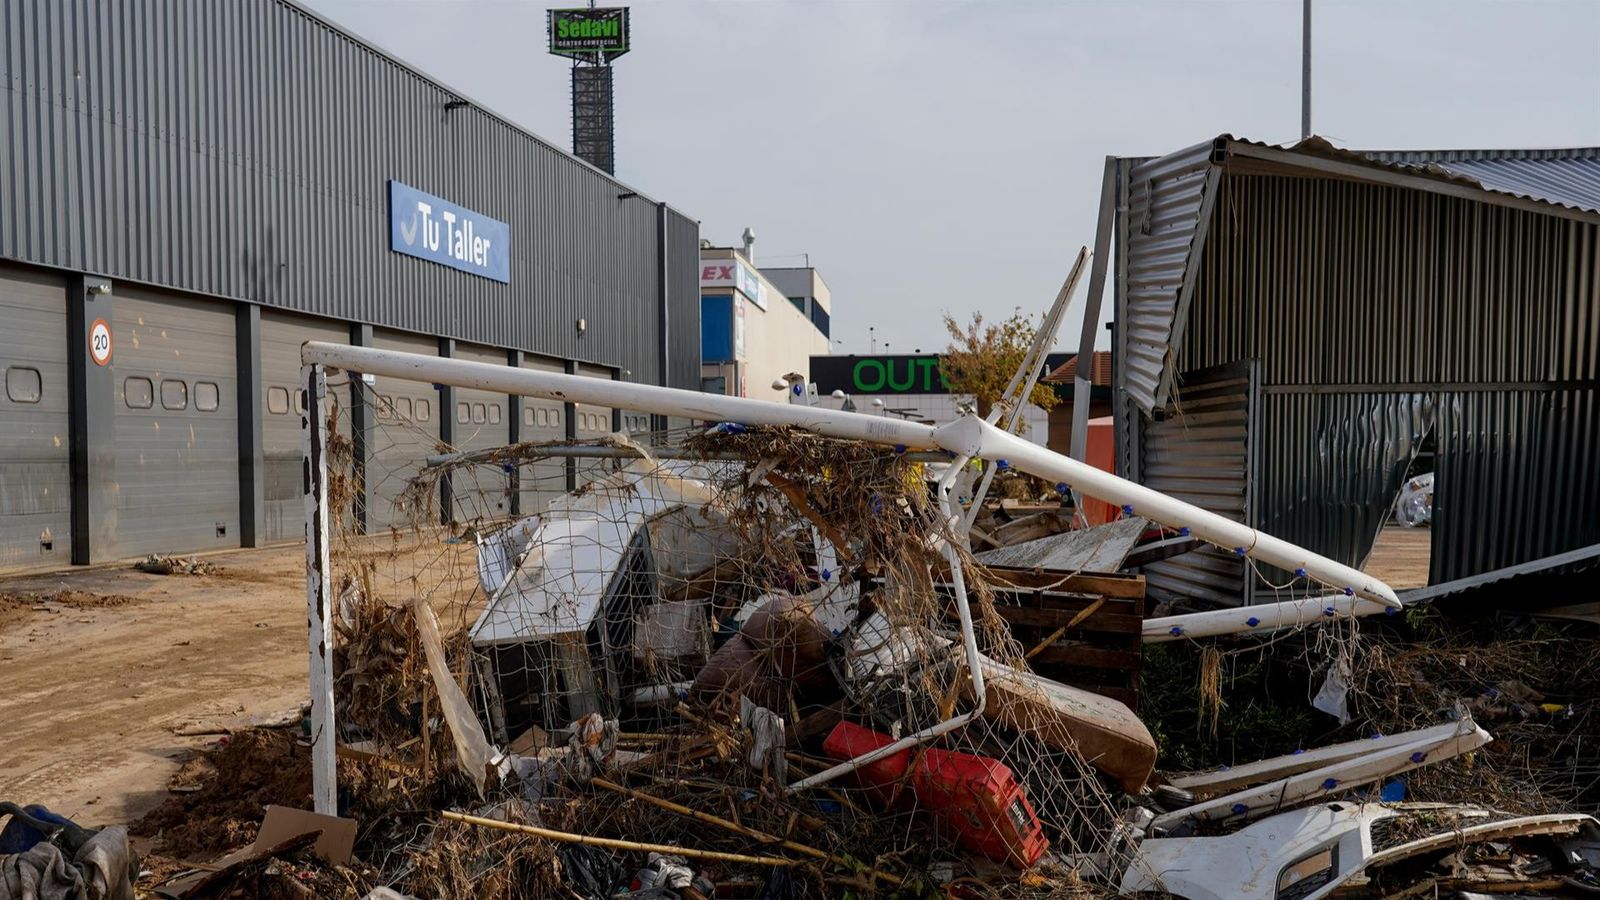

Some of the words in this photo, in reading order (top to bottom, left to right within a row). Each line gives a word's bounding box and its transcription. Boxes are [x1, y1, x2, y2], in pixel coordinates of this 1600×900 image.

[559, 17, 618, 38] Sedaví
[417, 201, 440, 252] Tu
[443, 210, 491, 268] Taller
[701, 265, 735, 280] EX
[94, 334, 108, 350] 20
